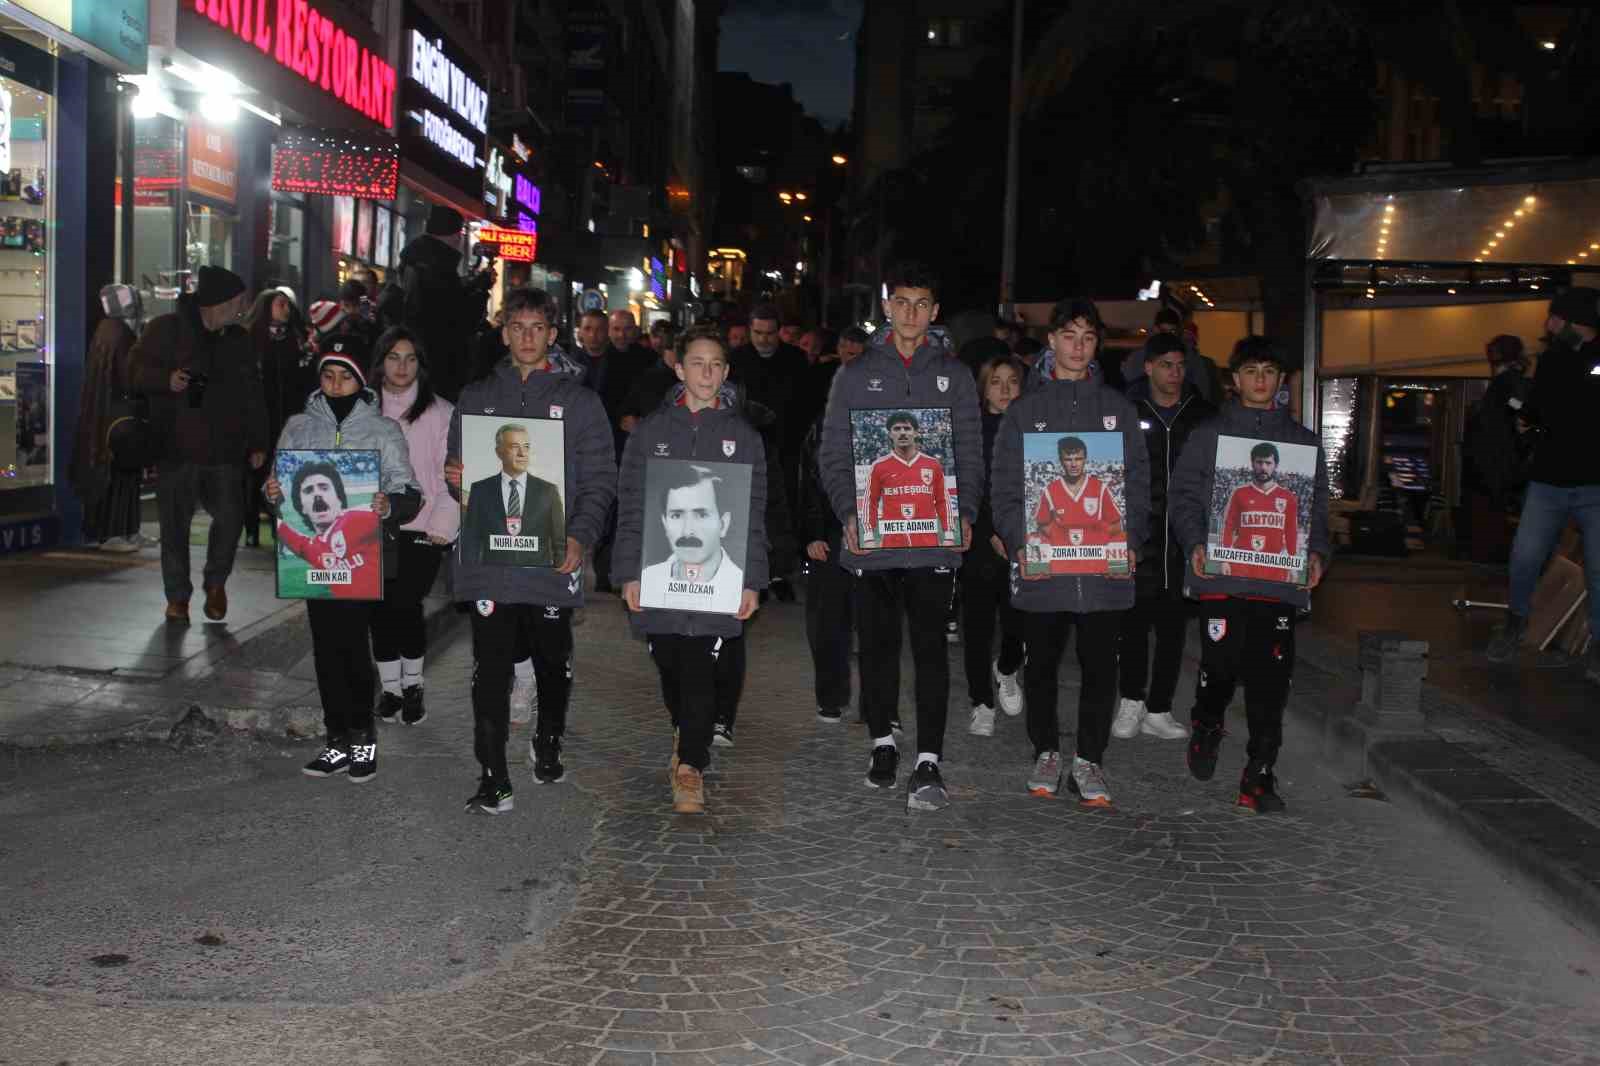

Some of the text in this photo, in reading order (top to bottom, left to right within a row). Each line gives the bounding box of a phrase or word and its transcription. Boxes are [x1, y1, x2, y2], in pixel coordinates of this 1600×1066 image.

[275, 0, 396, 129] RESTORANT
[884, 521, 934, 533] METE ADANIR
[514, 538, 535, 549] ASAN
[1052, 547, 1077, 558] ZORAN
[1213, 548, 1253, 562] MUZAFFER
[332, 571, 348, 583] KAR
[668, 582, 687, 593] ASIM
